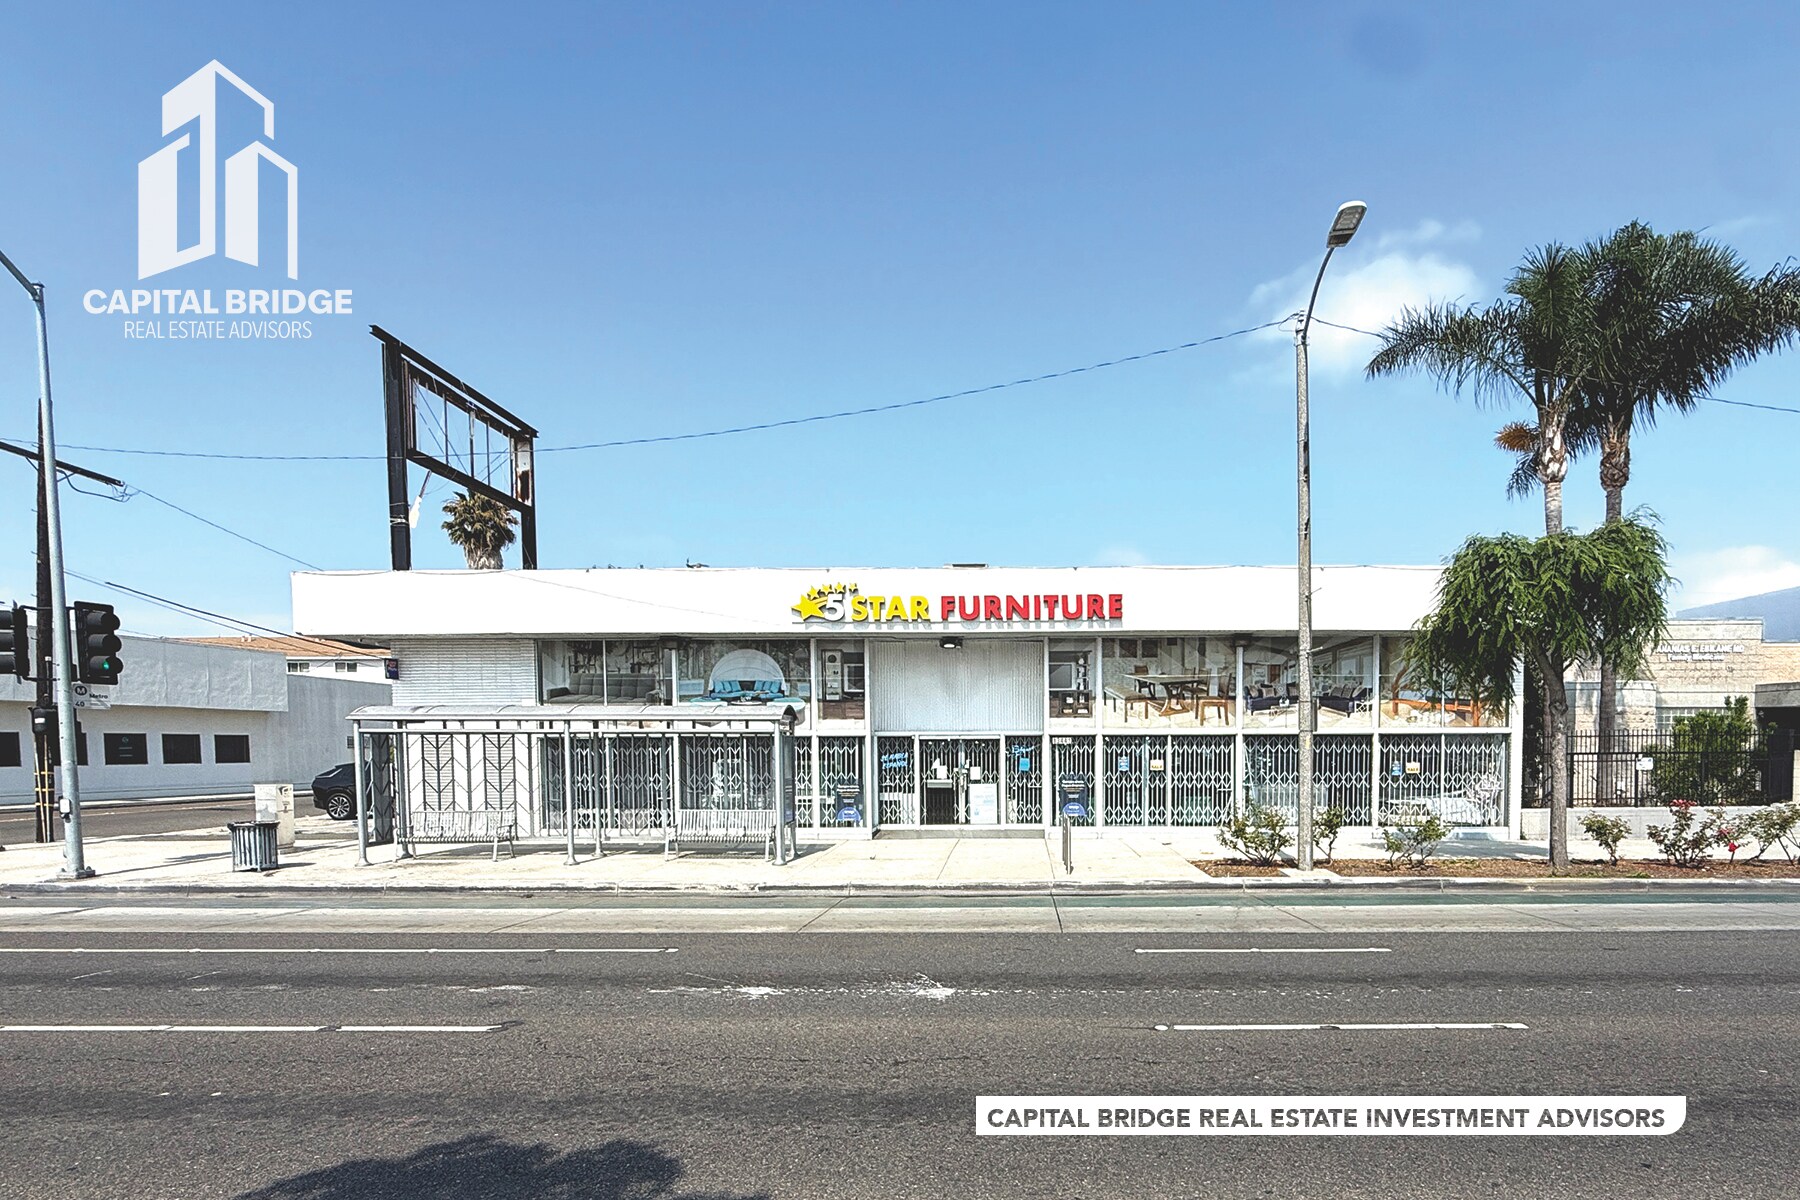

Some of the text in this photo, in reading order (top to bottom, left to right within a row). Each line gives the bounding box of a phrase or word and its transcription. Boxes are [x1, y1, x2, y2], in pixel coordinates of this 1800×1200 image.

[824, 594, 1123, 622] 5 STAR FURNITURE
